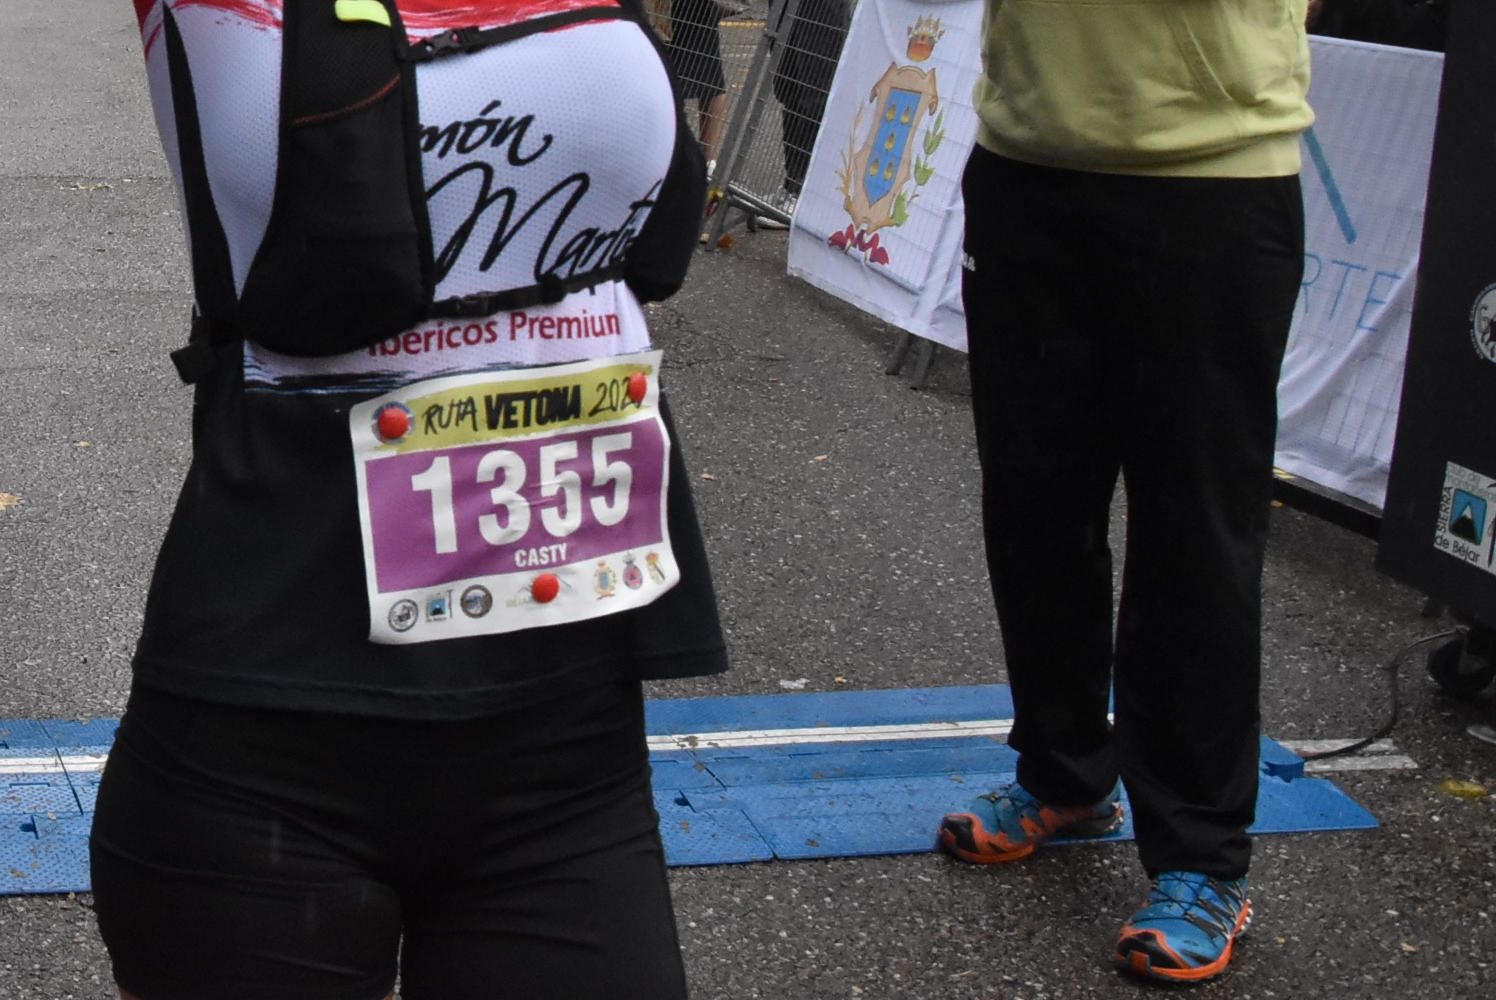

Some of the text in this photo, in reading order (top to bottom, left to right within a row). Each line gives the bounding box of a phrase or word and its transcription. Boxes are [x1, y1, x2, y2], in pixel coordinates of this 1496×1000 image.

[422, 395, 480, 436] RUTA
[484, 384, 582, 431] VETONA
[411, 431, 633, 555] 1355
[1437, 487, 1453, 533] SIERRA
[514, 543, 569, 569] CASTY
[1435, 535, 1450, 549] de
